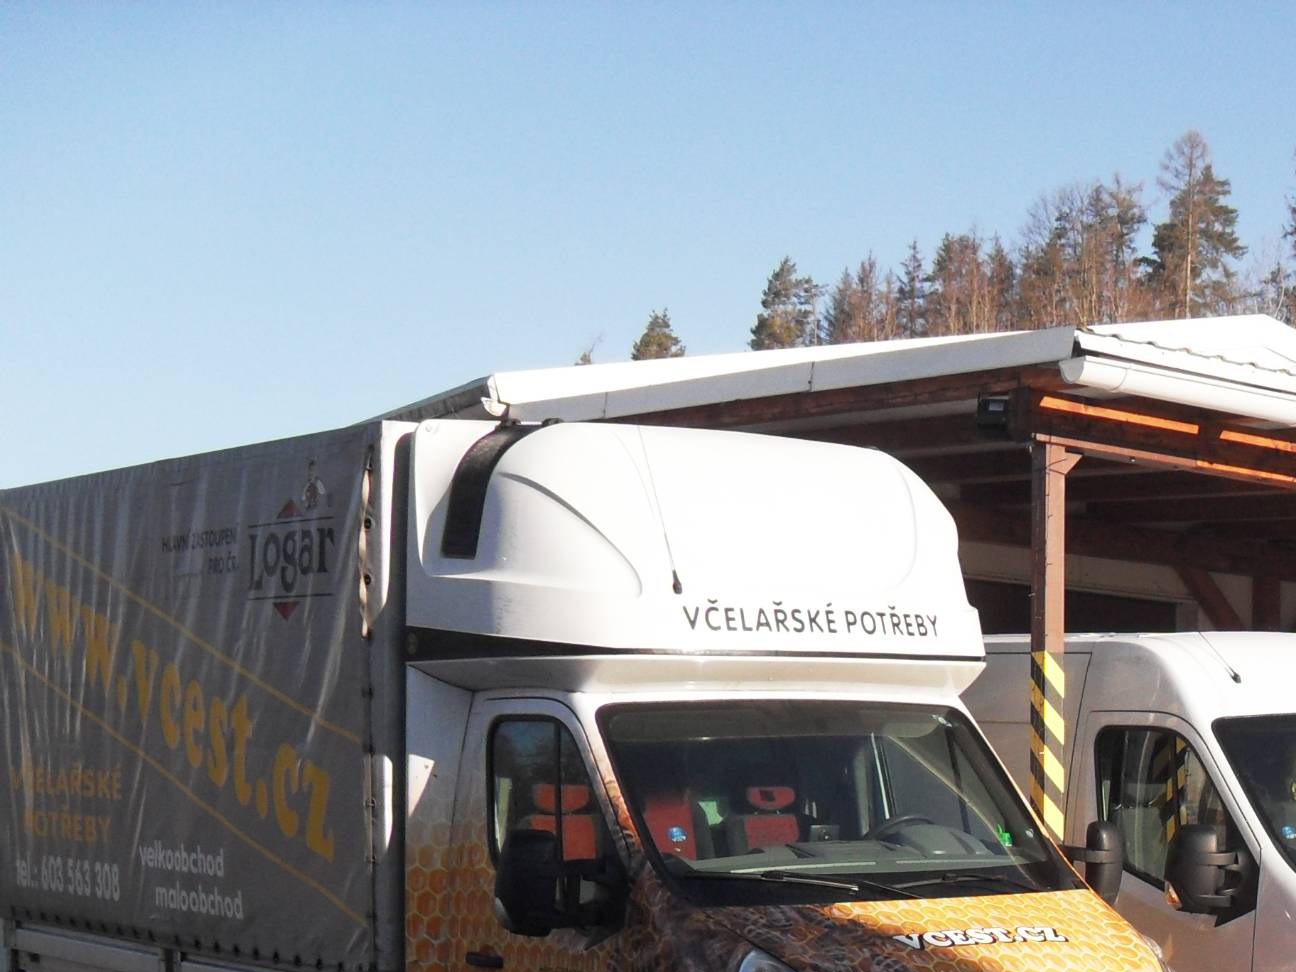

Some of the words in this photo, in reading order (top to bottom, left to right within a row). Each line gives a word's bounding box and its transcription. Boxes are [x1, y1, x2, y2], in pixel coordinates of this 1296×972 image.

[247, 526, 336, 593] Logar
[682, 598, 838, 633] VČELAŘSKÉ
[844, 605, 938, 637] POTŘEBY
[11, 551, 335, 862] www.vcest.cz
[41, 855, 64, 893] 603
[67, 857, 91, 897] 563
[94, 861, 120, 901] 308
[139, 839, 225, 877] velkoobchod
[155, 880, 244, 920] maloobchod
[892, 925, 1070, 950] VCEST.CZ
